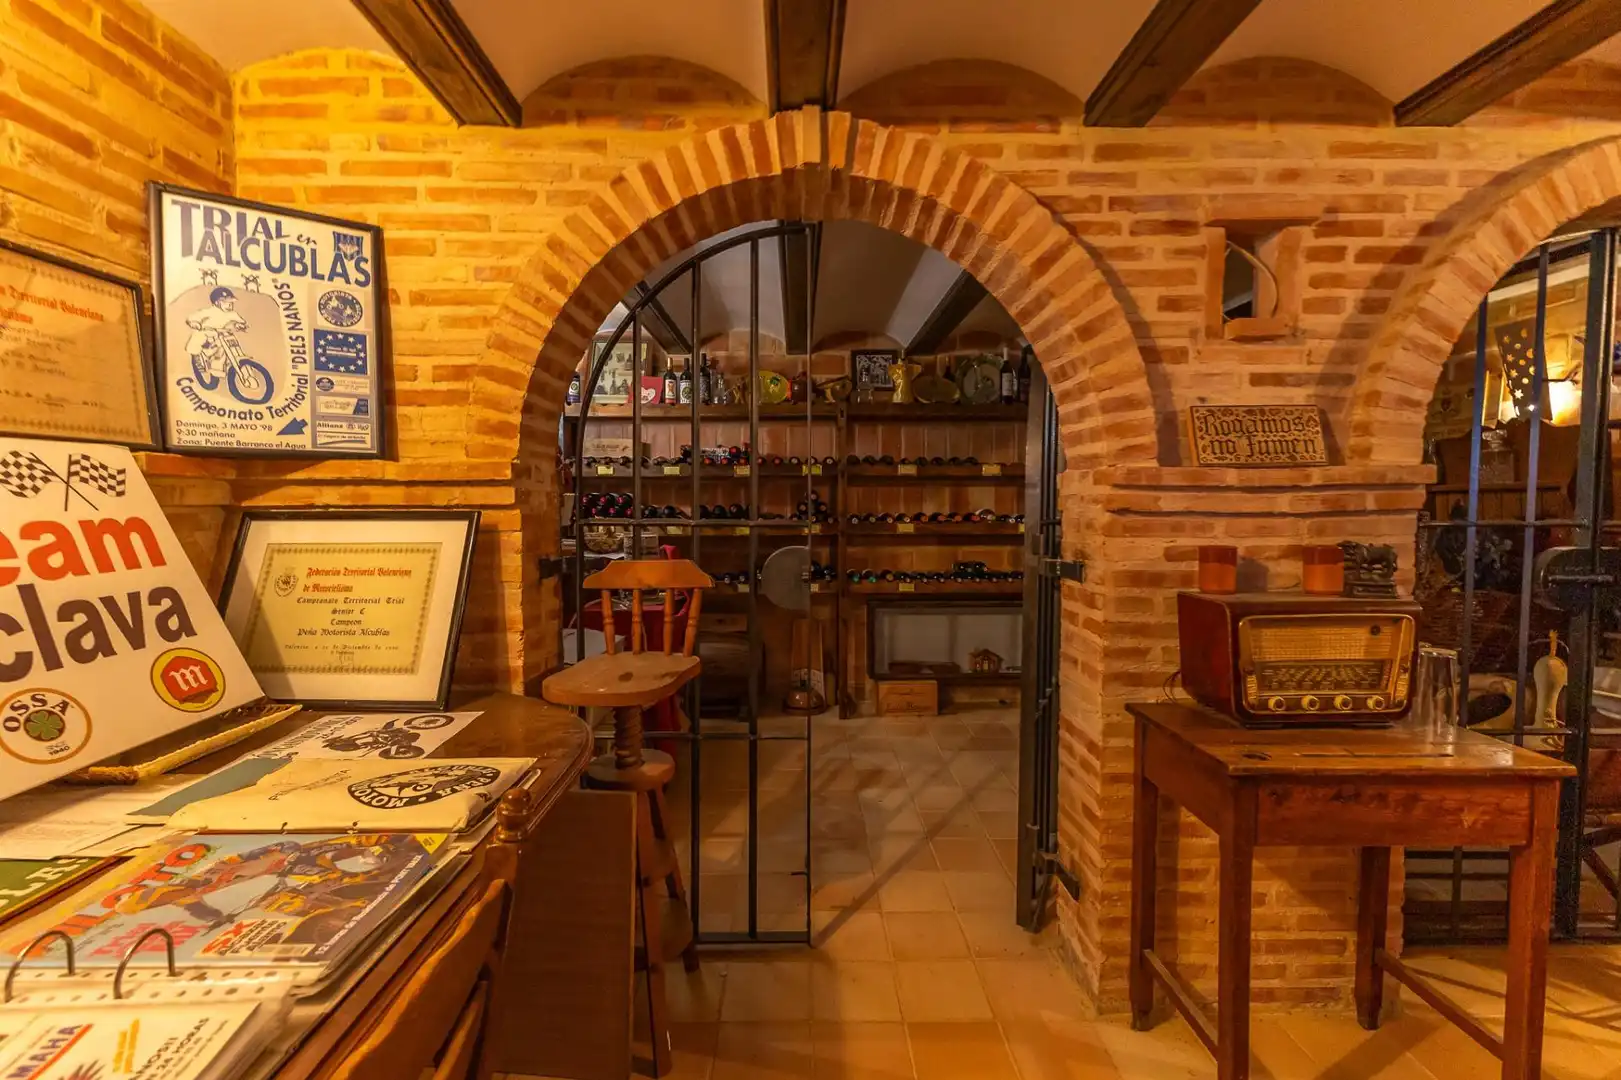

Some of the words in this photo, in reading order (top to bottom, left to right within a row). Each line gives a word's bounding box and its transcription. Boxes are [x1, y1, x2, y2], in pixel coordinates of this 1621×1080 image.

[171, 200, 290, 257] TRIAL
[296, 233, 318, 246] en
[196, 230, 372, 288] ALCUBLAS
[176, 377, 264, 420] Campeonato
[266, 373, 309, 420] Territorial
[199, 430, 236, 438] mañana
[230, 423, 258, 431] MAYO
[204, 439, 234, 447] Puente
[235, 440, 274, 448] Barranco
[275, 441, 283, 449] el
[284, 442, 307, 451] Agua
[1208, 438, 1238, 456] no
[3, 693, 70, 732] OSSA
